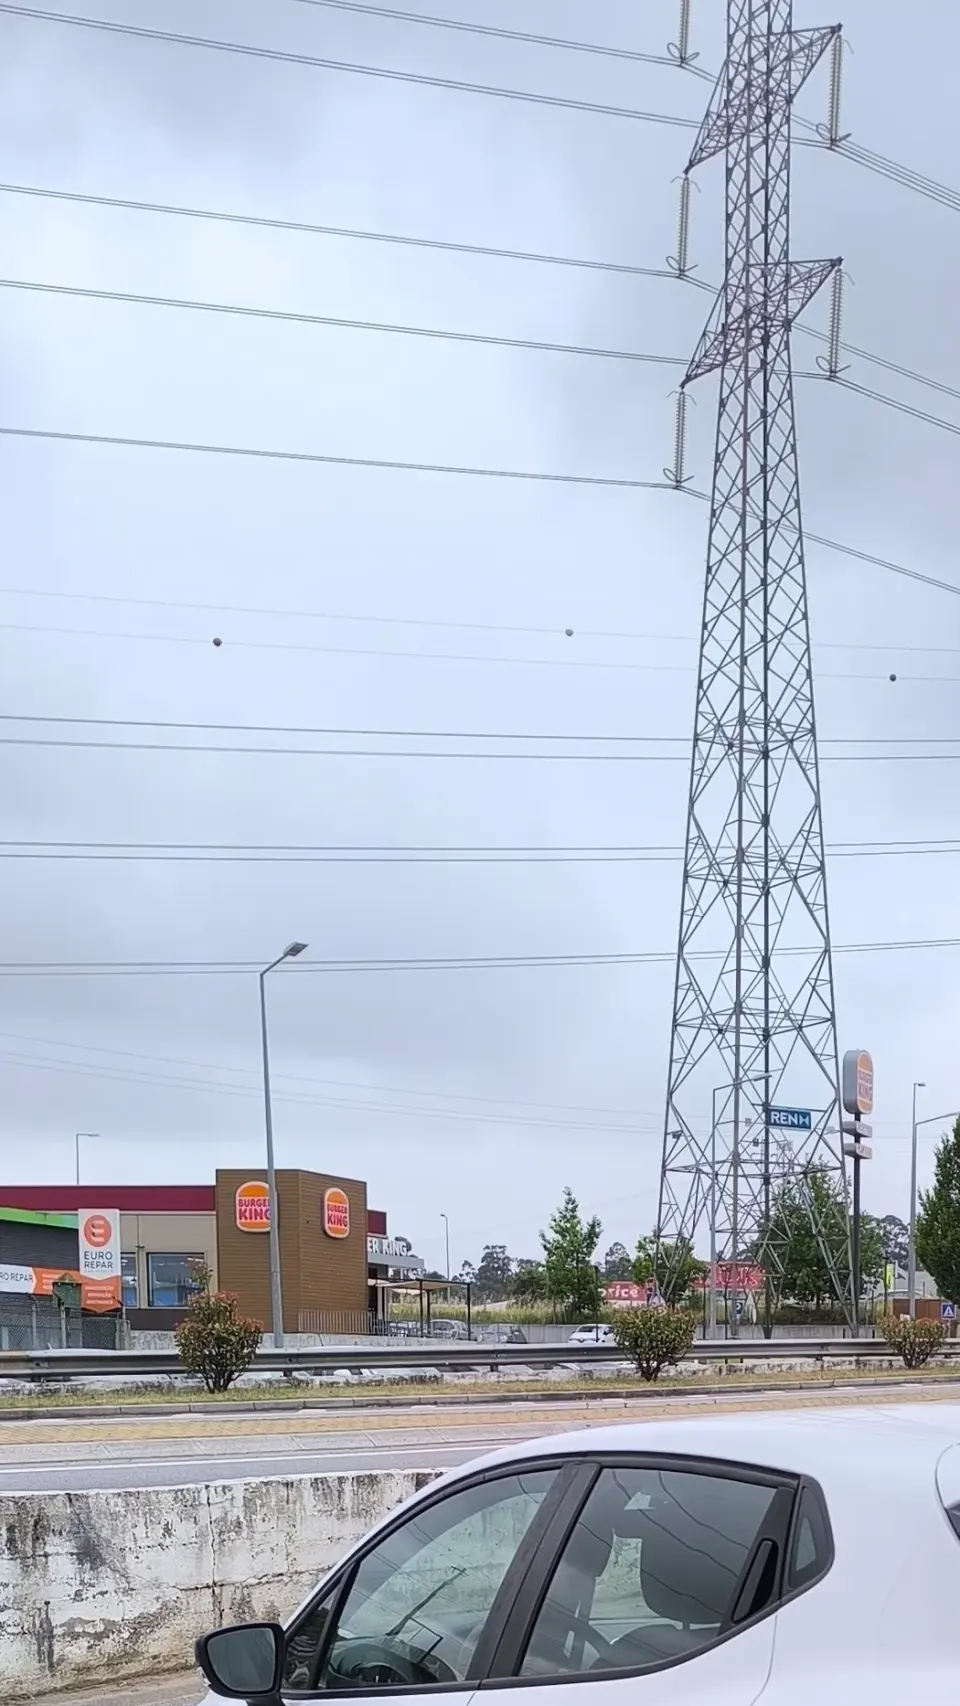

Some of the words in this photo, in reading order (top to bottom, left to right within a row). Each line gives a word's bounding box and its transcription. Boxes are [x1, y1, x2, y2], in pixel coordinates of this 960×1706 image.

[770, 1111, 798, 1126] REN
[238, 1198, 270, 1208] BURGE
[327, 1213, 348, 1228] KING
[382, 1239, 408, 1256] KING
[84, 1250, 113, 1260] EURO
[84, 1260, 113, 1269] REPAR
